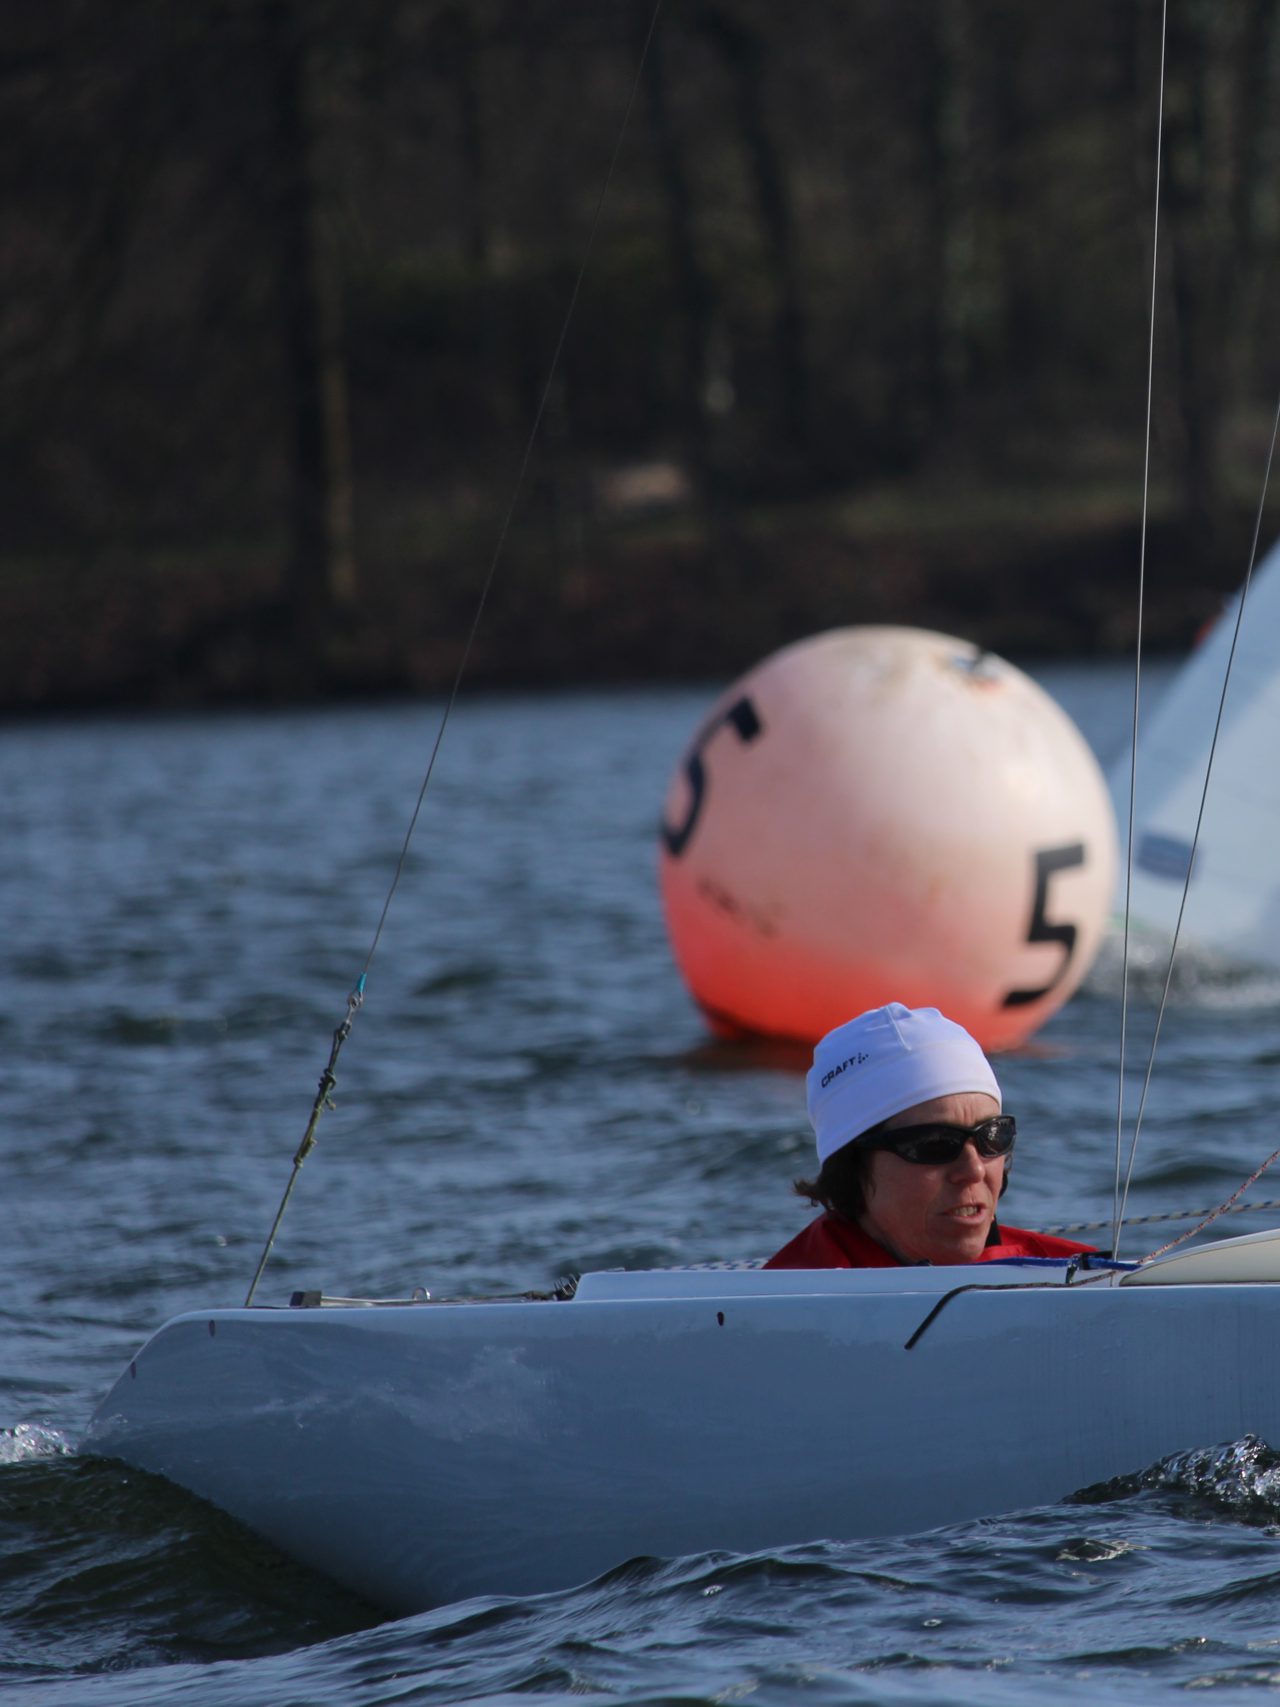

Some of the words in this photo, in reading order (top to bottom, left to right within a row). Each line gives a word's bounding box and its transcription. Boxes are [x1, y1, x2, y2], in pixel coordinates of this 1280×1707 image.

[661, 696, 763, 859] 5
[998, 841, 1084, 1010] 5
[821, 1056, 856, 1089] CRAFT
